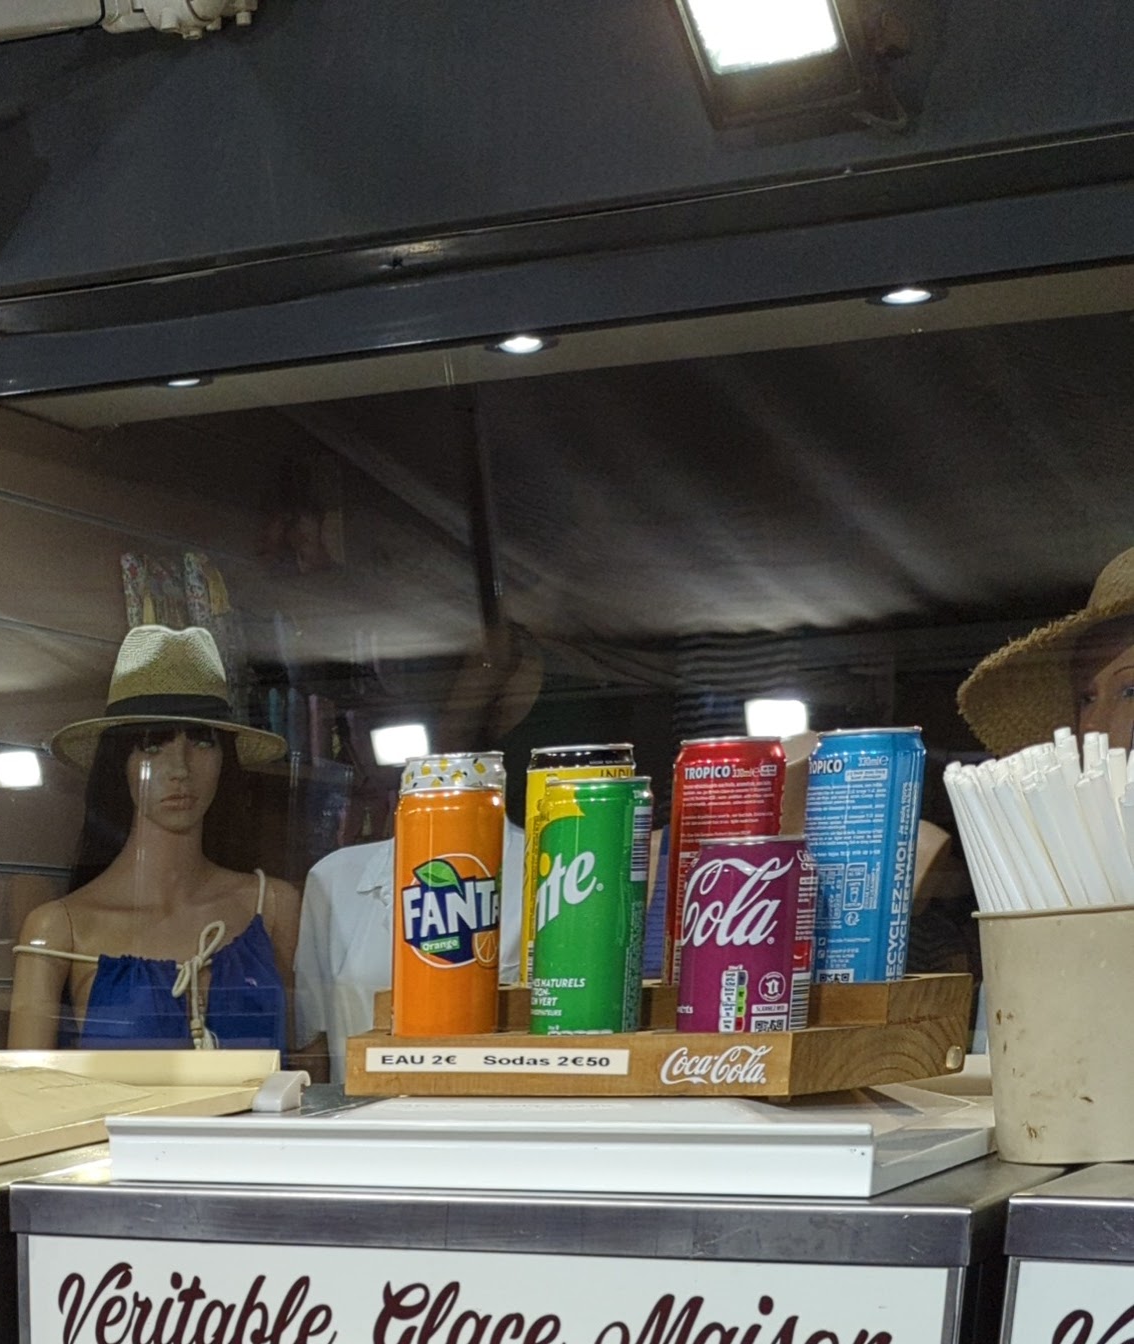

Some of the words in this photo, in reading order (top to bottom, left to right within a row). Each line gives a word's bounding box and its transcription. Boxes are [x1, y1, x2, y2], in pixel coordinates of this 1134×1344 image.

[685, 765, 730, 779] TROPICO
[422, 937, 459, 952] Orange
[381, 1055, 424, 1065] EAU
[431, 1055, 457, 1065] 2€
[483, 1055, 550, 1066] Sodas
[557, 1056, 610, 1067] 2€50
[660, 1045, 773, 1084] Coca-Cola
